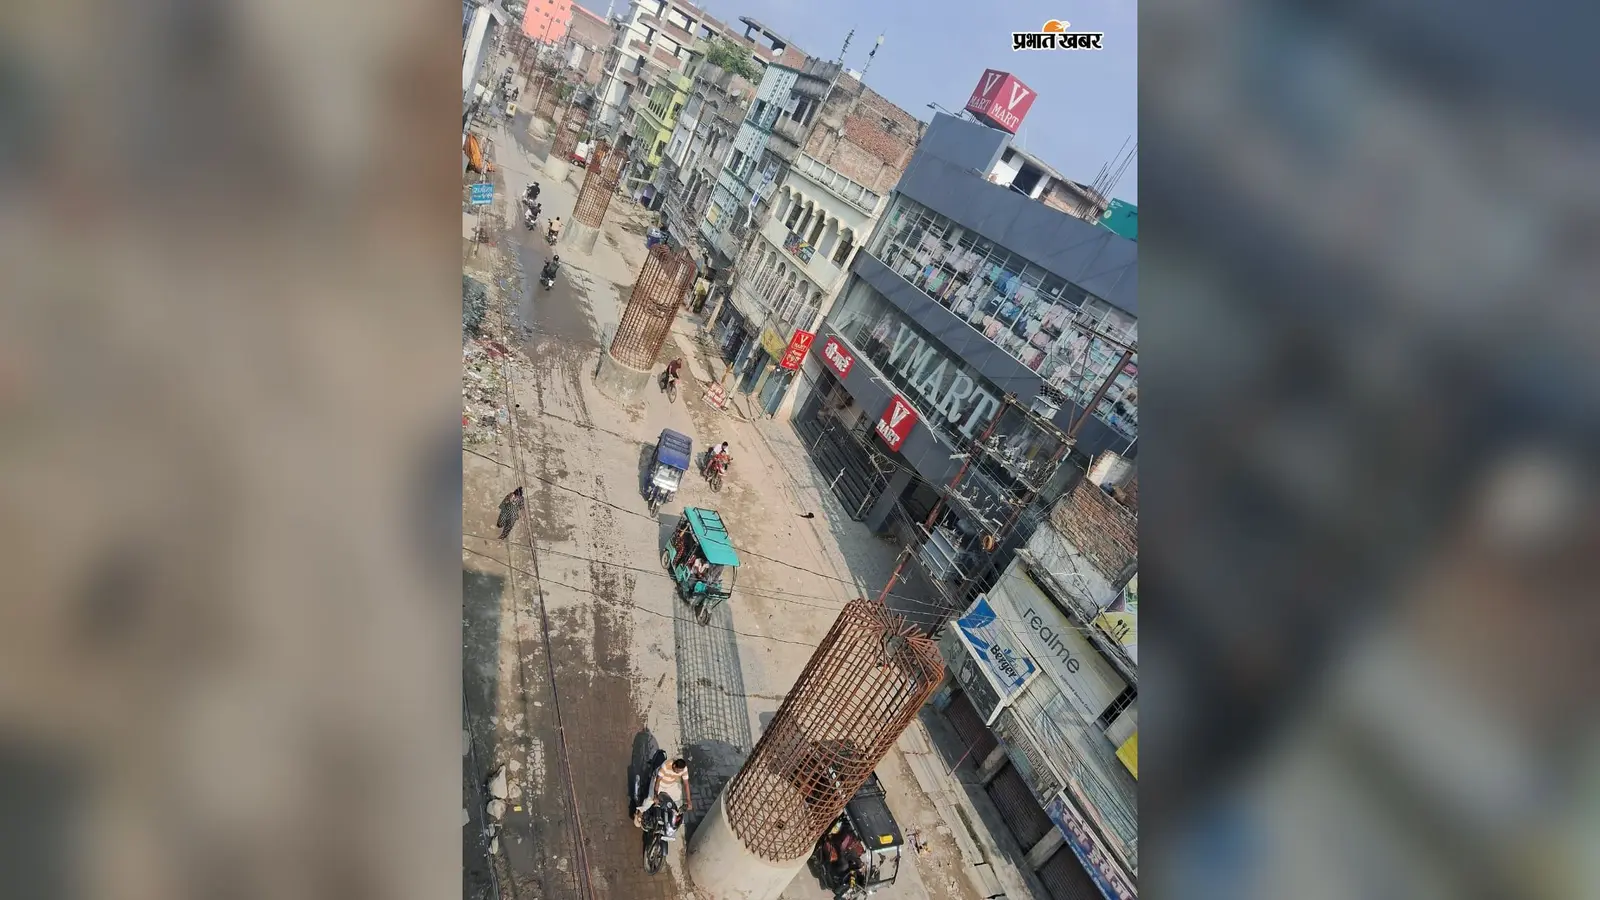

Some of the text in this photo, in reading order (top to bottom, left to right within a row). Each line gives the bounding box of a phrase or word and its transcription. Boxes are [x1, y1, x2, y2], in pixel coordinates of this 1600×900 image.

[981, 72, 1003, 97] V
[1007, 81, 1029, 110] V
[968, 95, 991, 111] MART
[991, 103, 1020, 129] MART
[799, 334, 809, 345] V
[890, 401, 911, 429] V
[875, 419, 901, 446] MART
[1023, 608, 1081, 674] realme
[990, 644, 1018, 678] Berger
